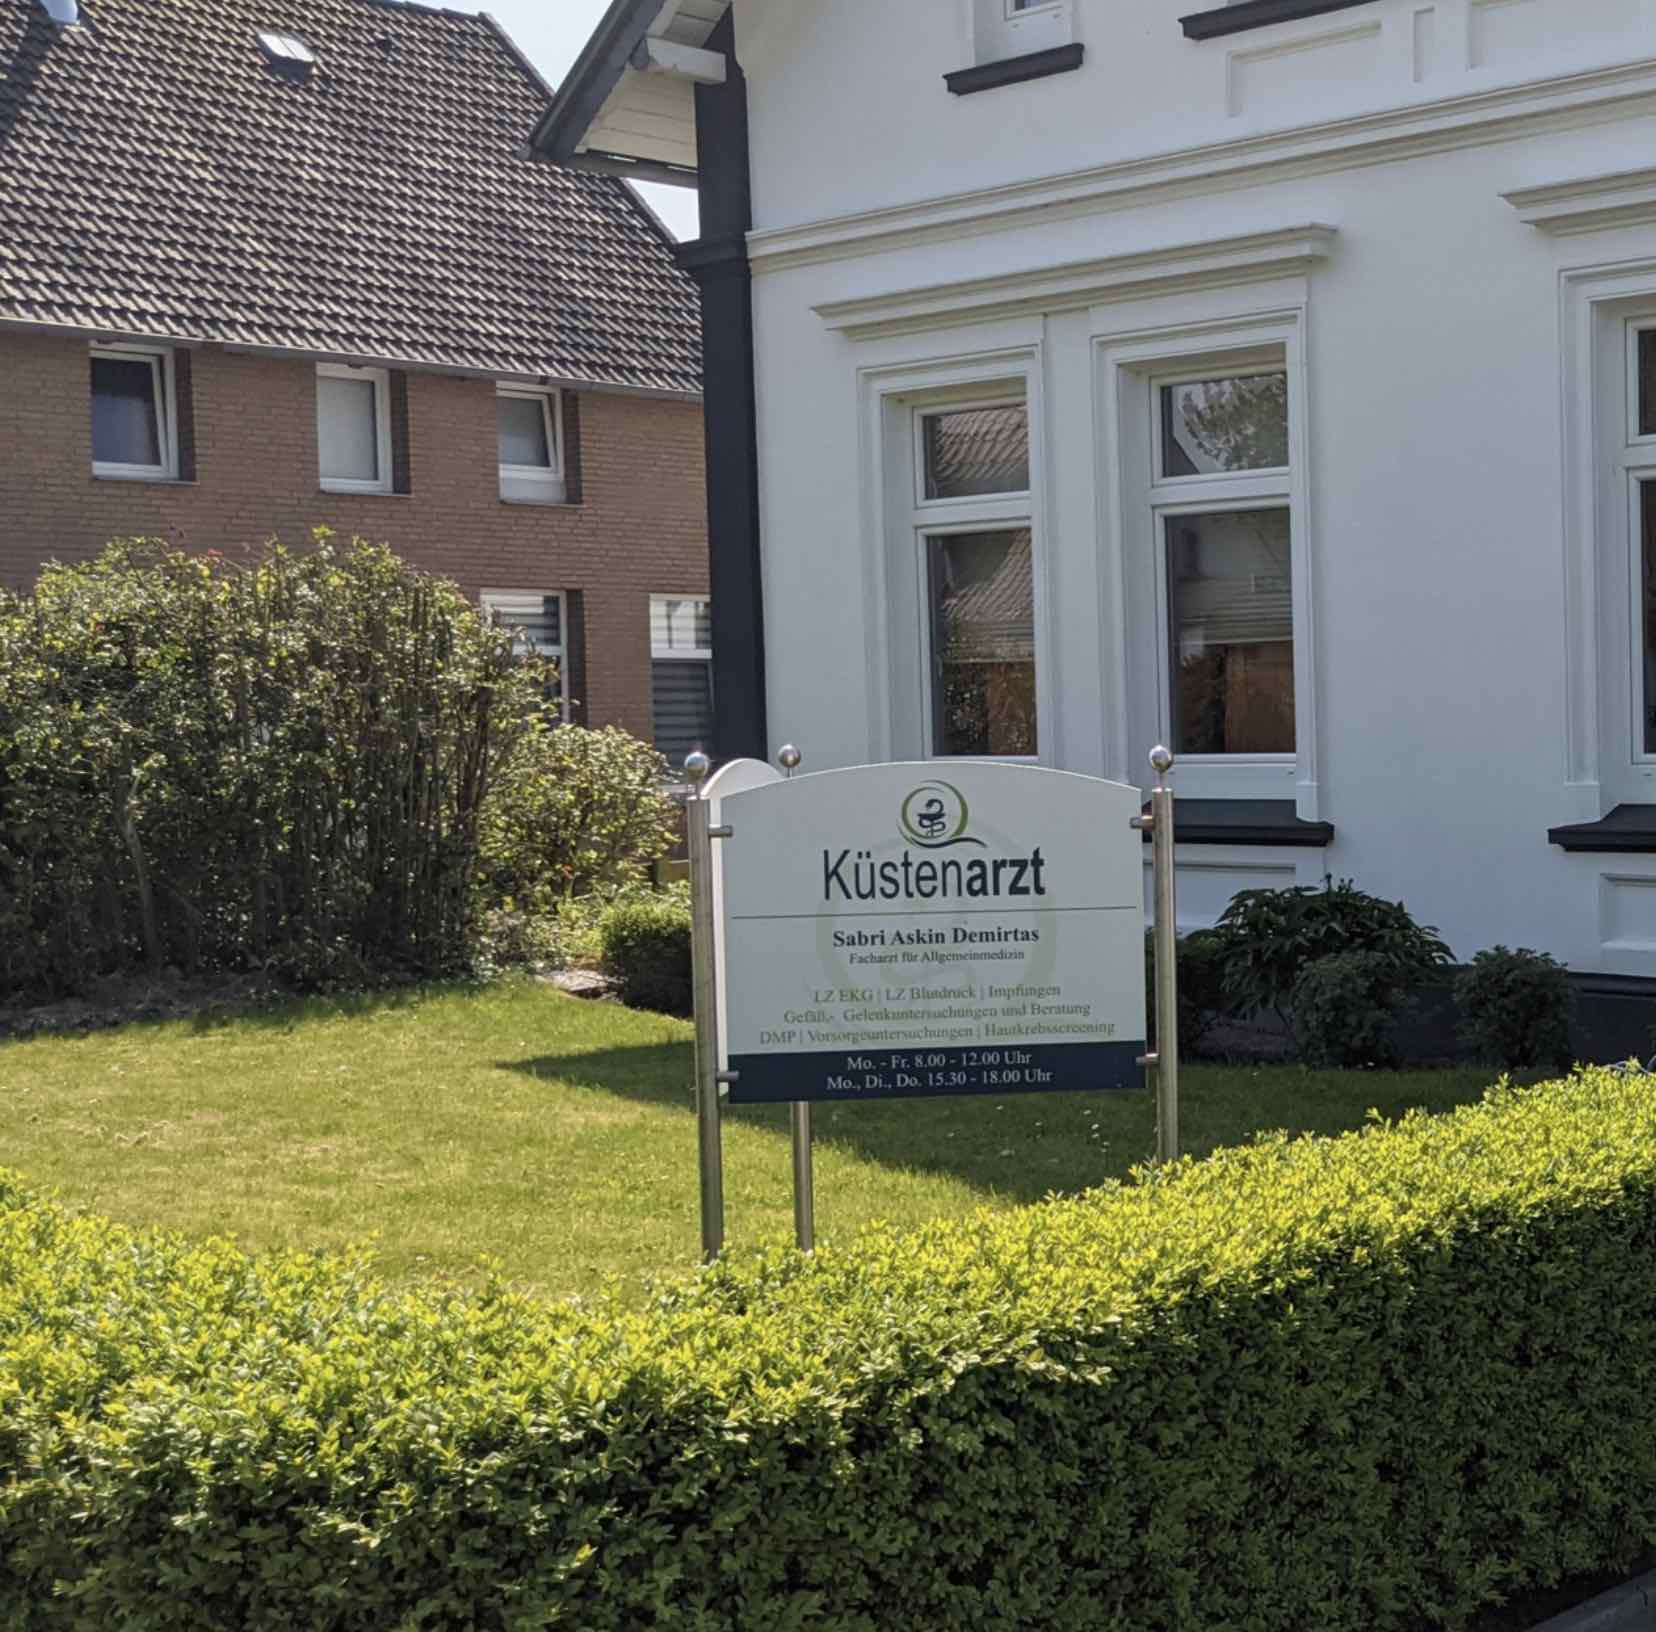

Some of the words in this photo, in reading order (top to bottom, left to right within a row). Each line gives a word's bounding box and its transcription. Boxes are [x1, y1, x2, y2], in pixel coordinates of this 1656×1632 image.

[823, 846, 1045, 900] Küstenarzt
[833, 929, 885, 947] Sabri
[890, 927, 945, 945] Askin
[952, 926, 1039, 943] Demirtas
[849, 952, 898, 964] Facharzt
[902, 951, 918, 962] für
[921, 948, 1025, 963] Allgemeinmedizin
[815, 988, 835, 1003] LZ
[839, 987, 873, 1002] EKG
[885, 987, 906, 1001] LZ
[911, 984, 976, 1000] Blutdruck
[988, 984, 1061, 1001] Impfungen
[843, 1005, 997, 1023] Gelenkuntersuchungen
[1001, 1003, 1026, 1017] und
[1030, 1003, 1090, 1018] Beratung
[760, 1030, 796, 1045] DMP
[985, 1021, 1115, 1038] Hautkrebsscreening
[847, 1057, 876, 1070] Mo.
[891, 1055, 910, 1069] Fr.
[915, 1054, 946, 1068] 8.00
[962, 1052, 1000, 1066] 12.00
[1004, 1051, 1032, 1065] Uhr
[896, 1074, 922, 1088] Do.
[928, 1071, 966, 1086] 15.30
[983, 1070, 1020, 1084] 18.00
[1024, 1068, 1053, 1083] Uhr
